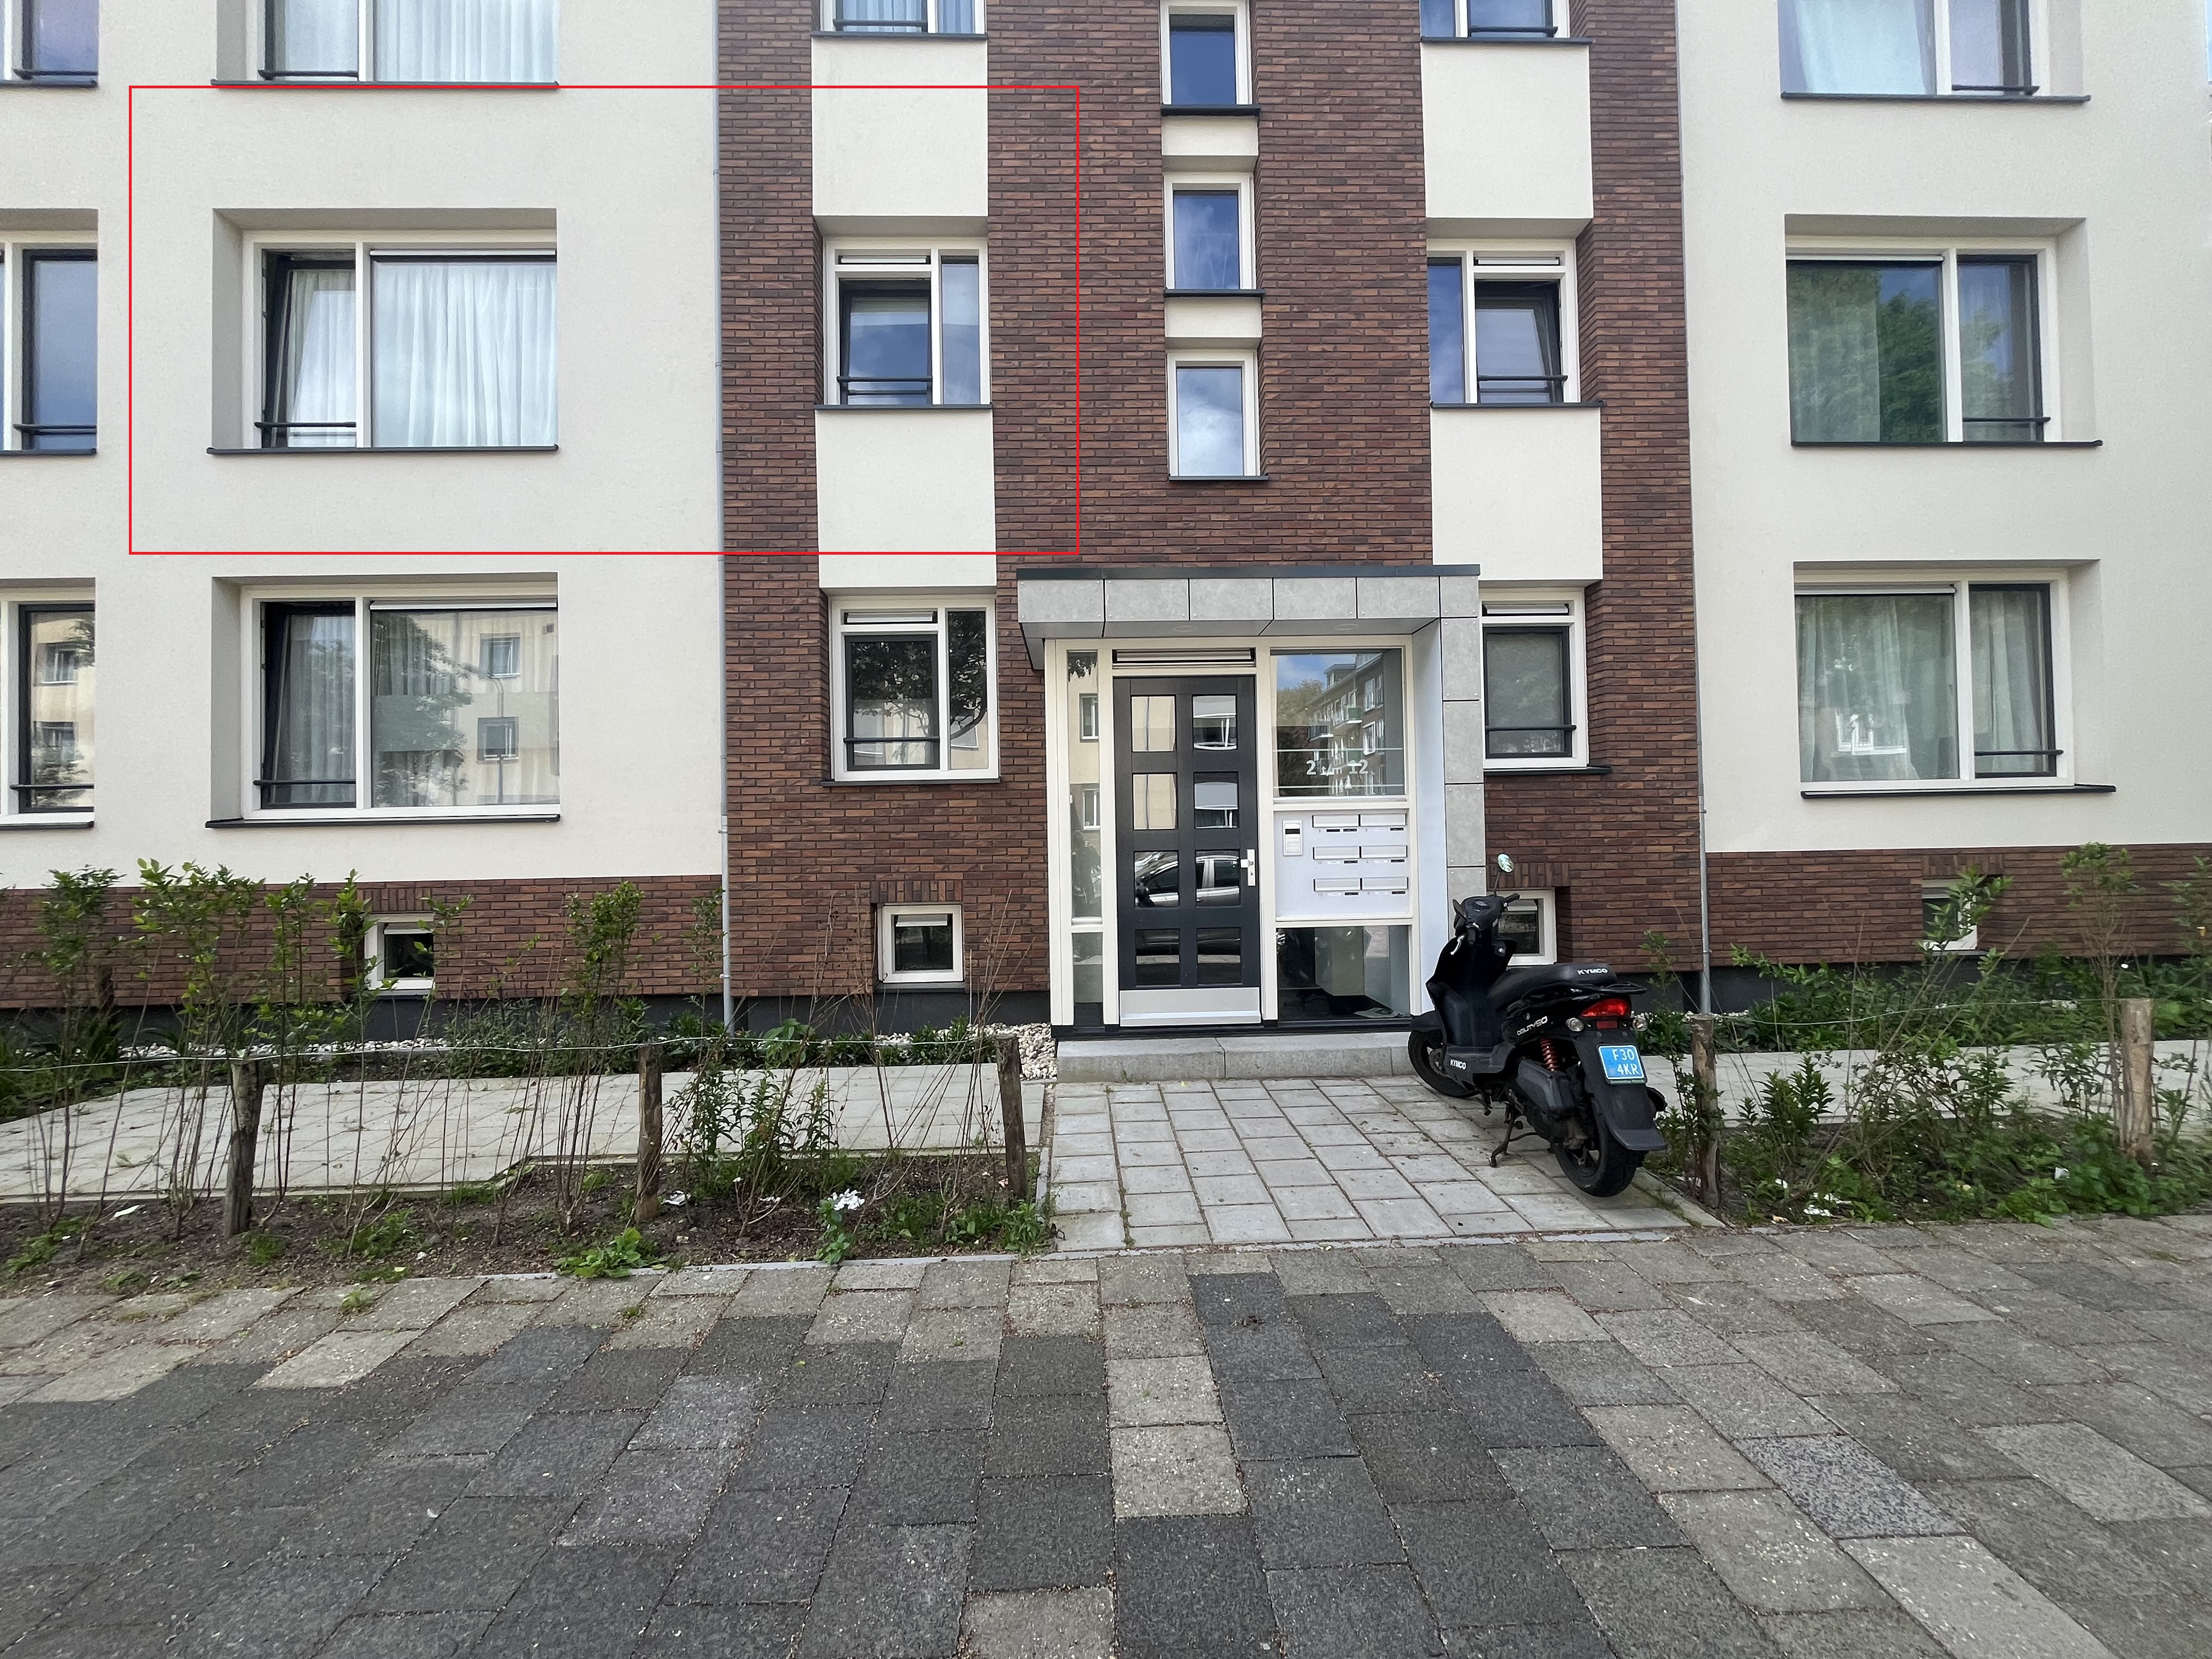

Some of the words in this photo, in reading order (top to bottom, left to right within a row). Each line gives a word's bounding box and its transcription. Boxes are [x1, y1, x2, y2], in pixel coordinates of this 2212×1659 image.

[1306, 760, 1316, 775] 2
[1348, 759, 1369, 774] 12
[1612, 1048, 1634, 1061] F30
[1450, 1059, 1466, 1070] KYMCO
[1617, 1063, 1640, 1075] 4KR
